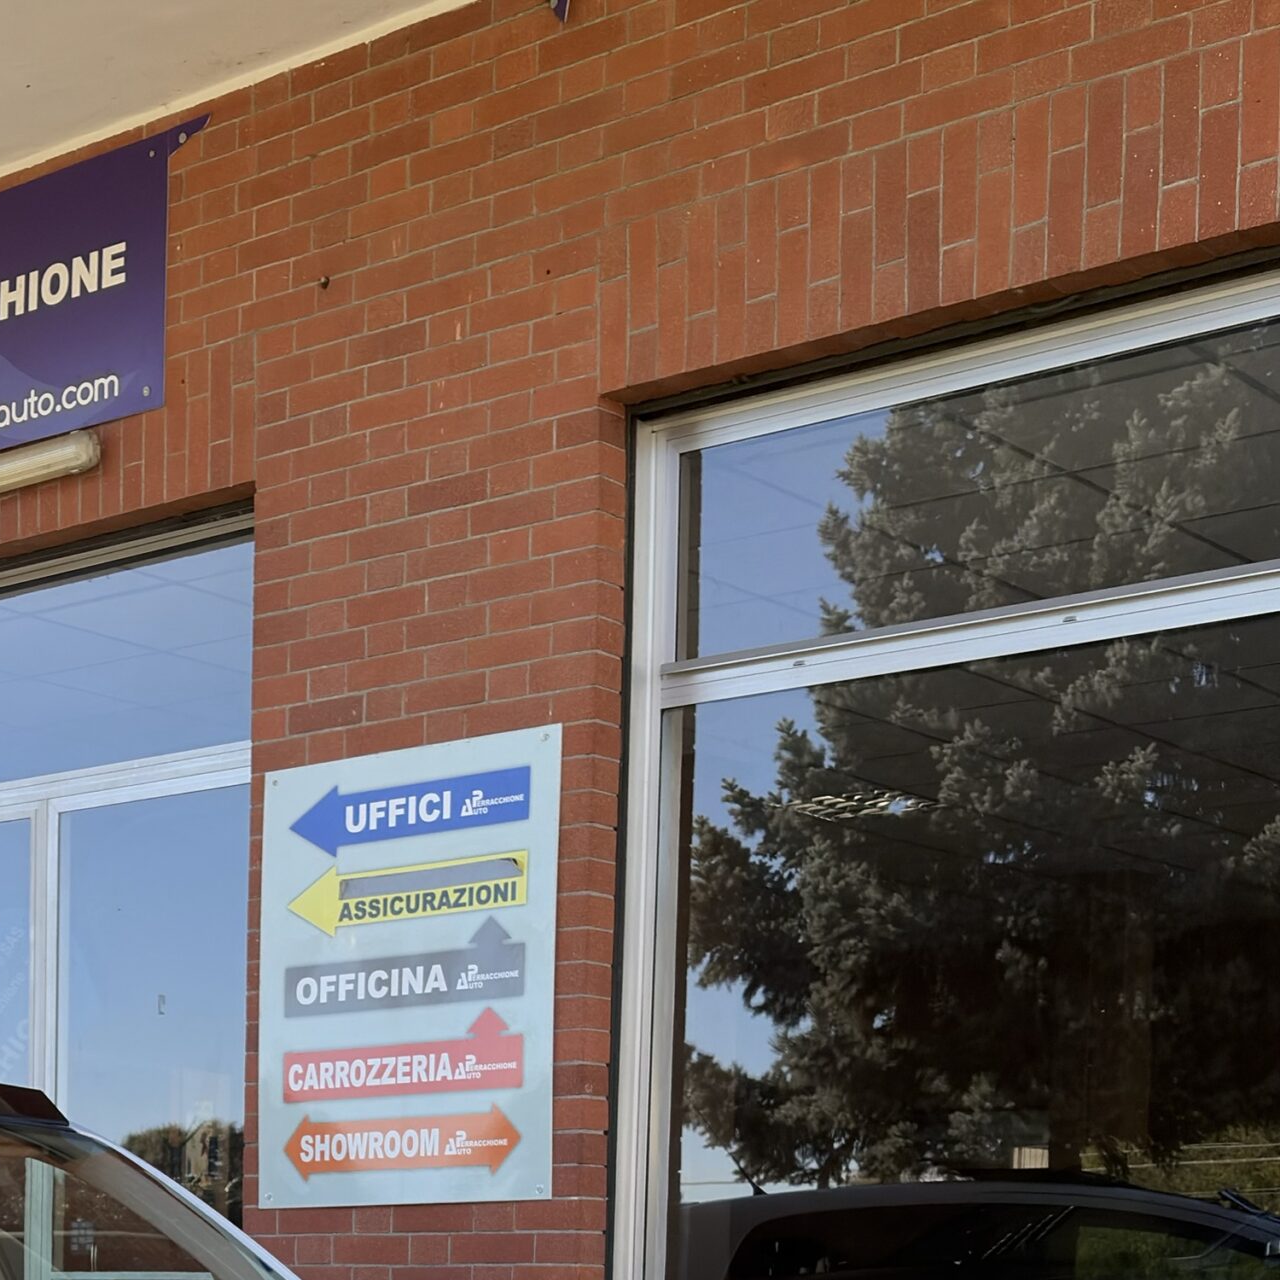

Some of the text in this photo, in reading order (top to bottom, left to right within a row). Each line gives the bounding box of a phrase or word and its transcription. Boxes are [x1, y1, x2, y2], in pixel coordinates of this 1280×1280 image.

[345, 790, 452, 834] UFFICI
[460, 798, 489, 817] AUTO
[338, 880, 517, 922] ASSICURAZIONI
[295, 964, 448, 1005] OFFICINA
[455, 972, 484, 990] AUTO
[288, 1052, 453, 1092] CARROZZERIA
[453, 1062, 482, 1080] AUTO
[300, 1127, 440, 1162] SHOWROOM
